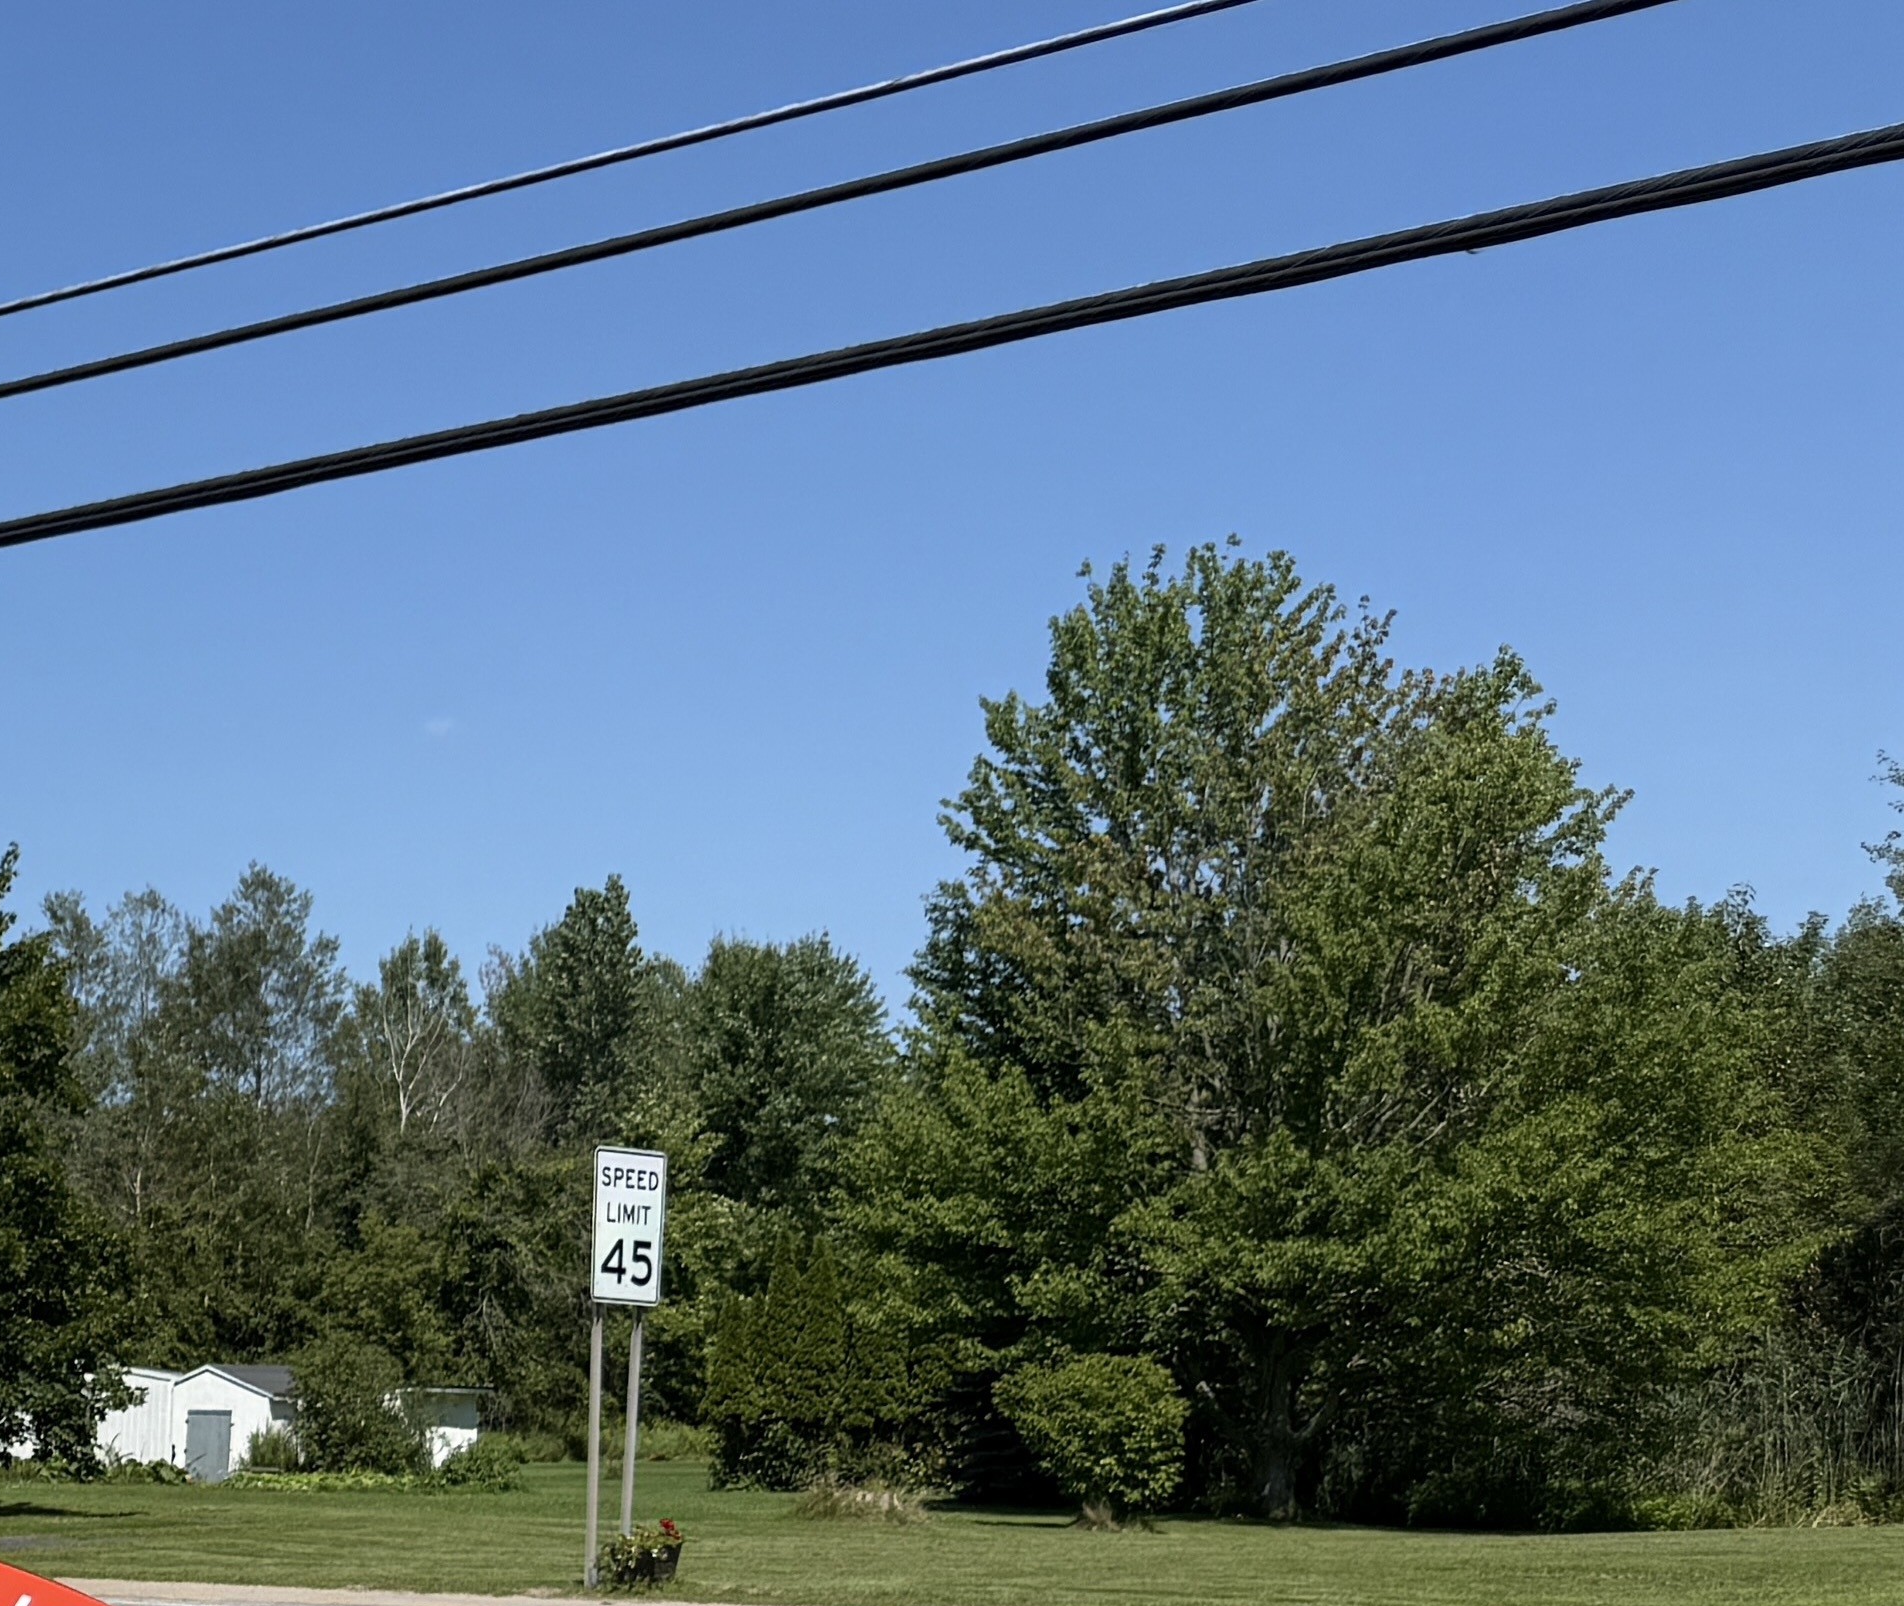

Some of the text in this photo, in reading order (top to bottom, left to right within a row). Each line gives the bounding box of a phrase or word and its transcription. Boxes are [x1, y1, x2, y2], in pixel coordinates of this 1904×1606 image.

[602, 1166, 659, 1191] SPEED
[607, 1202, 651, 1225] LIMIT
[601, 1238, 652, 1286] 45
